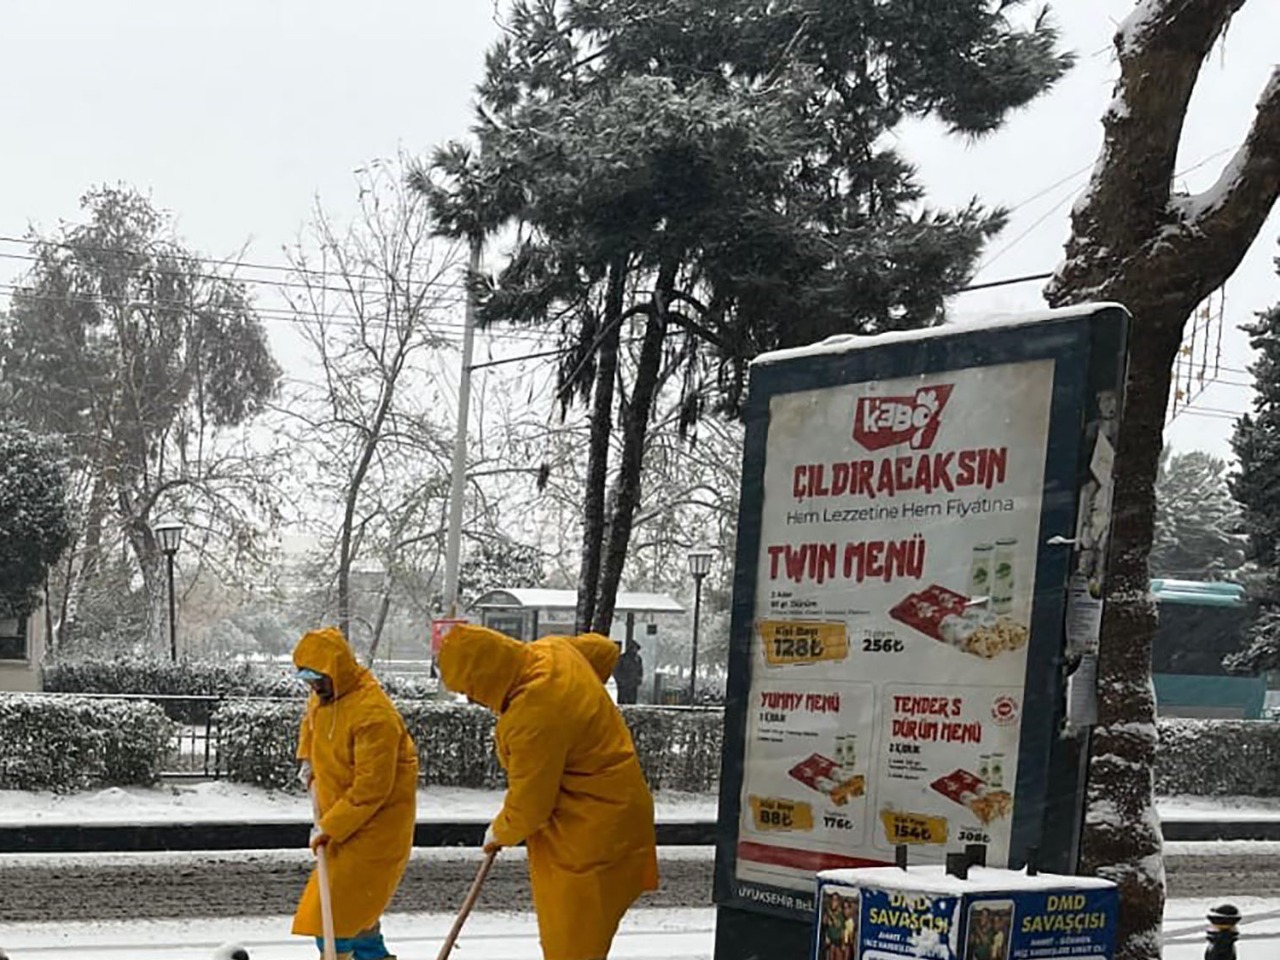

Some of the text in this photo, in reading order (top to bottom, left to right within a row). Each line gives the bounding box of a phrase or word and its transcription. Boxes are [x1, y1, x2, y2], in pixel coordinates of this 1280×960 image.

[786, 510, 820, 525] Hem
[823, 504, 899, 523] Lezzetine
[902, 502, 942, 518] Hem
[768, 533, 926, 584] TWIN MENÜ
[761, 691, 803, 711] YUMMY
[1047, 895, 1086, 912] DMD
